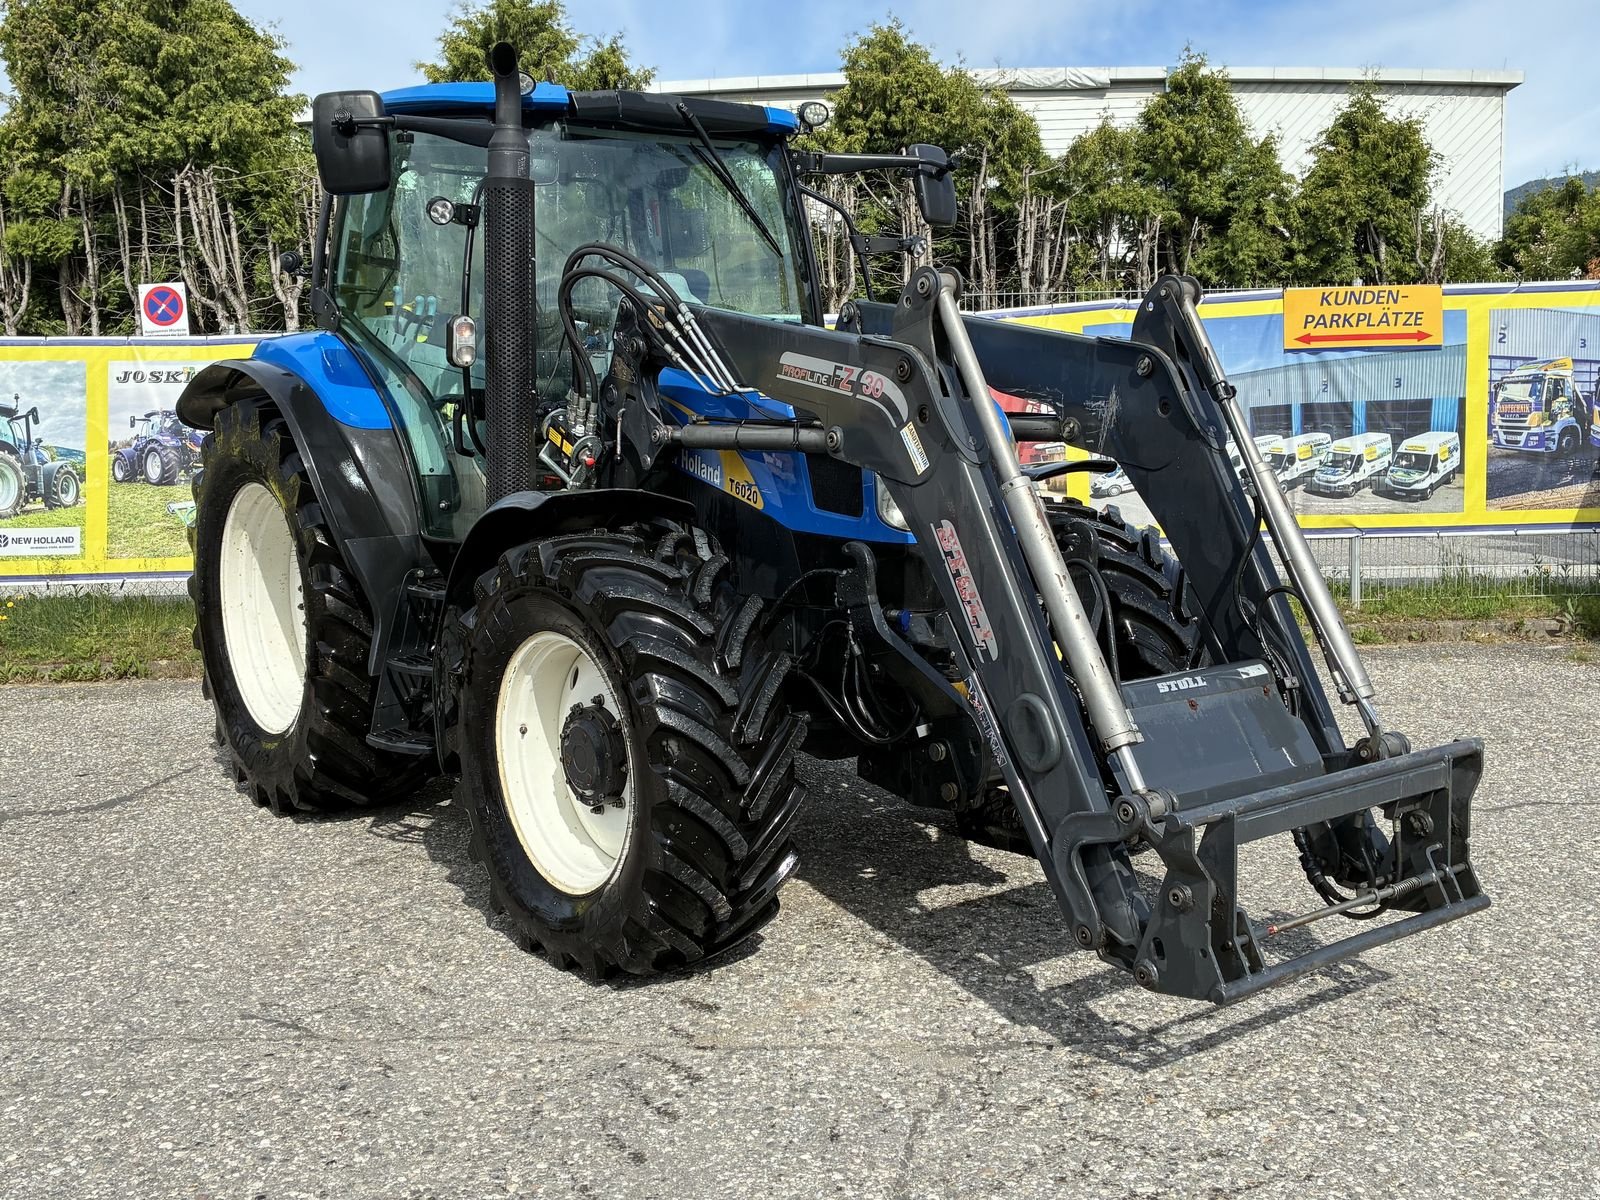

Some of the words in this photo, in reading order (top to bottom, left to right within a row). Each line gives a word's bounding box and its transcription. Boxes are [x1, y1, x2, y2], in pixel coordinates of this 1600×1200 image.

[1319, 289, 1409, 307] KUNDEN-
[1303, 307, 1424, 329] PARKPLÄTZE
[1497, 332, 1507, 344] 2
[1579, 338, 1587, 349] 3
[116, 370, 199, 384] JOSKI
[829, 364, 856, 392] FZ
[862, 373, 885, 399] 30
[1394, 377, 1402, 388] 3
[681, 448, 720, 486] Holland
[729, 477, 758, 505] T6020
[11, 537, 32, 545] NEW
[33, 536, 75, 544] HOLLAND
[1157, 675, 1207, 694] STOLL
